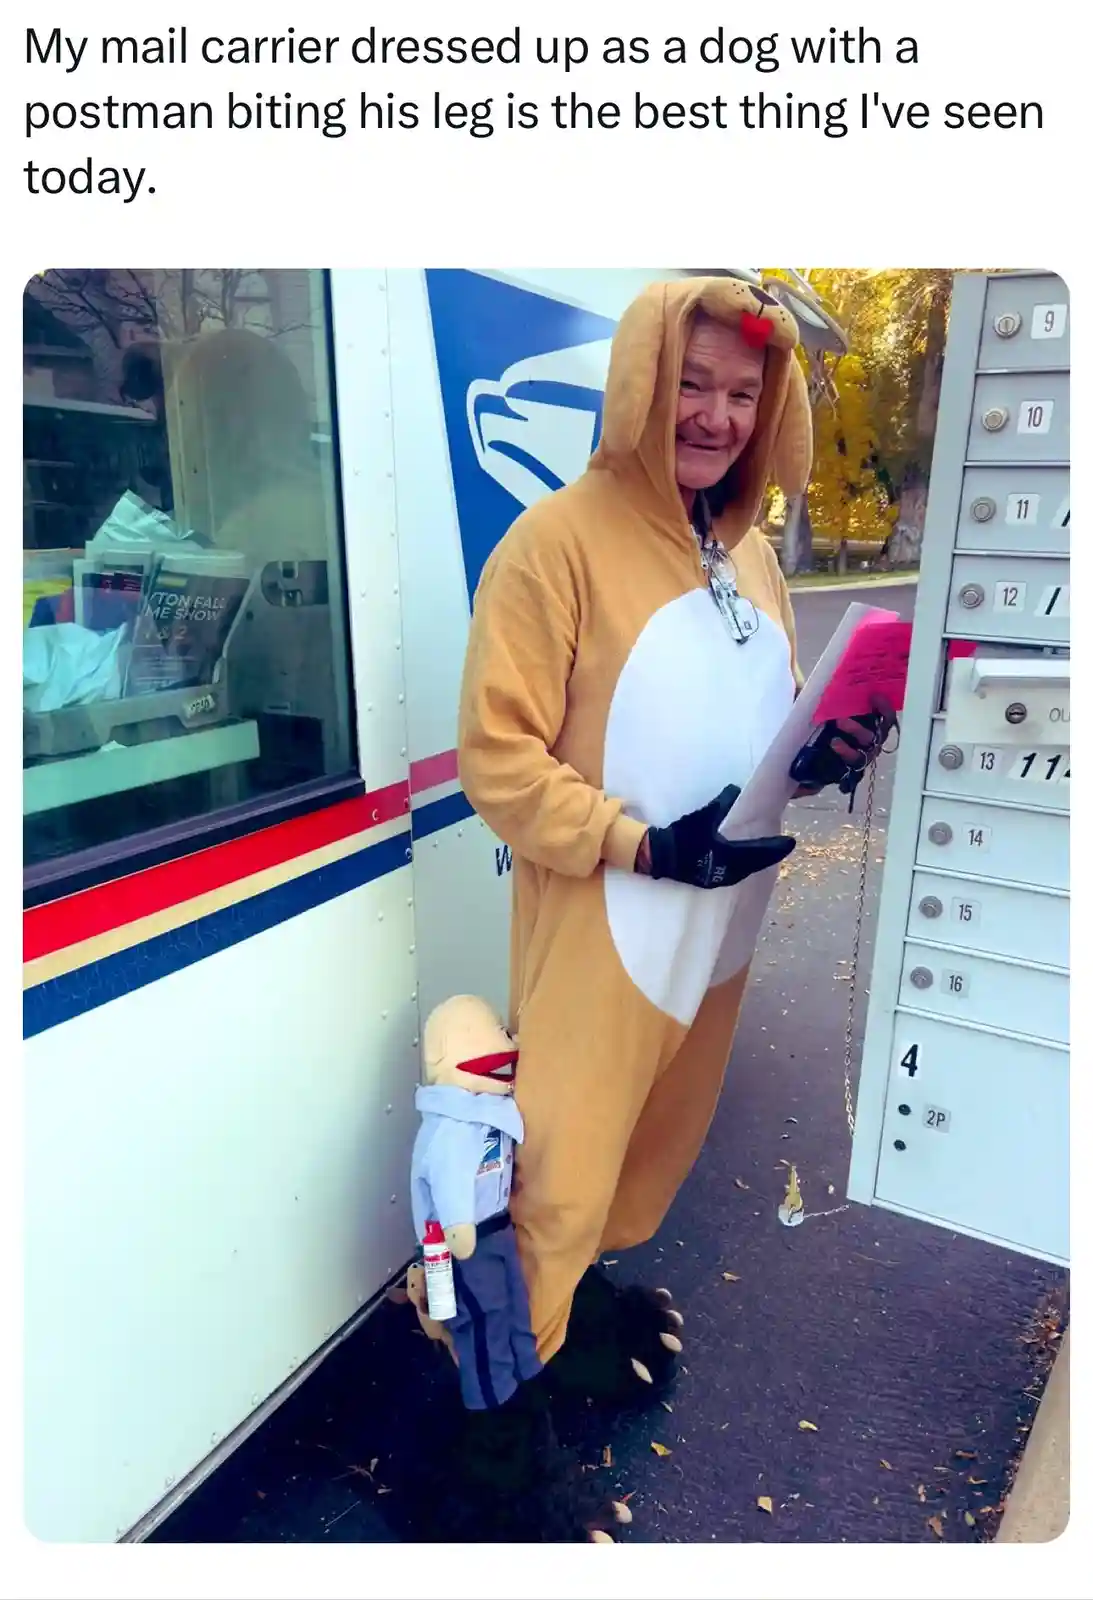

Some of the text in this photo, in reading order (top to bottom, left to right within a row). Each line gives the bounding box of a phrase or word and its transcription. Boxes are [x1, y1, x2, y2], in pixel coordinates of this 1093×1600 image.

[1044, 310, 1055, 333] 9
[1027, 406, 1043, 428] 10
[1016, 499, 1030, 520] 11
[1003, 587, 1019, 608] 12
[174, 607, 219, 621] SHOW
[980, 751, 995, 771] 13
[1020, 752, 1070, 780] 11
[968, 829, 983, 848] 14
[959, 903, 973, 922] 15
[949, 974, 963, 993] 16
[900, 1043, 919, 1078] 4
[927, 1110, 946, 1128] 2P
